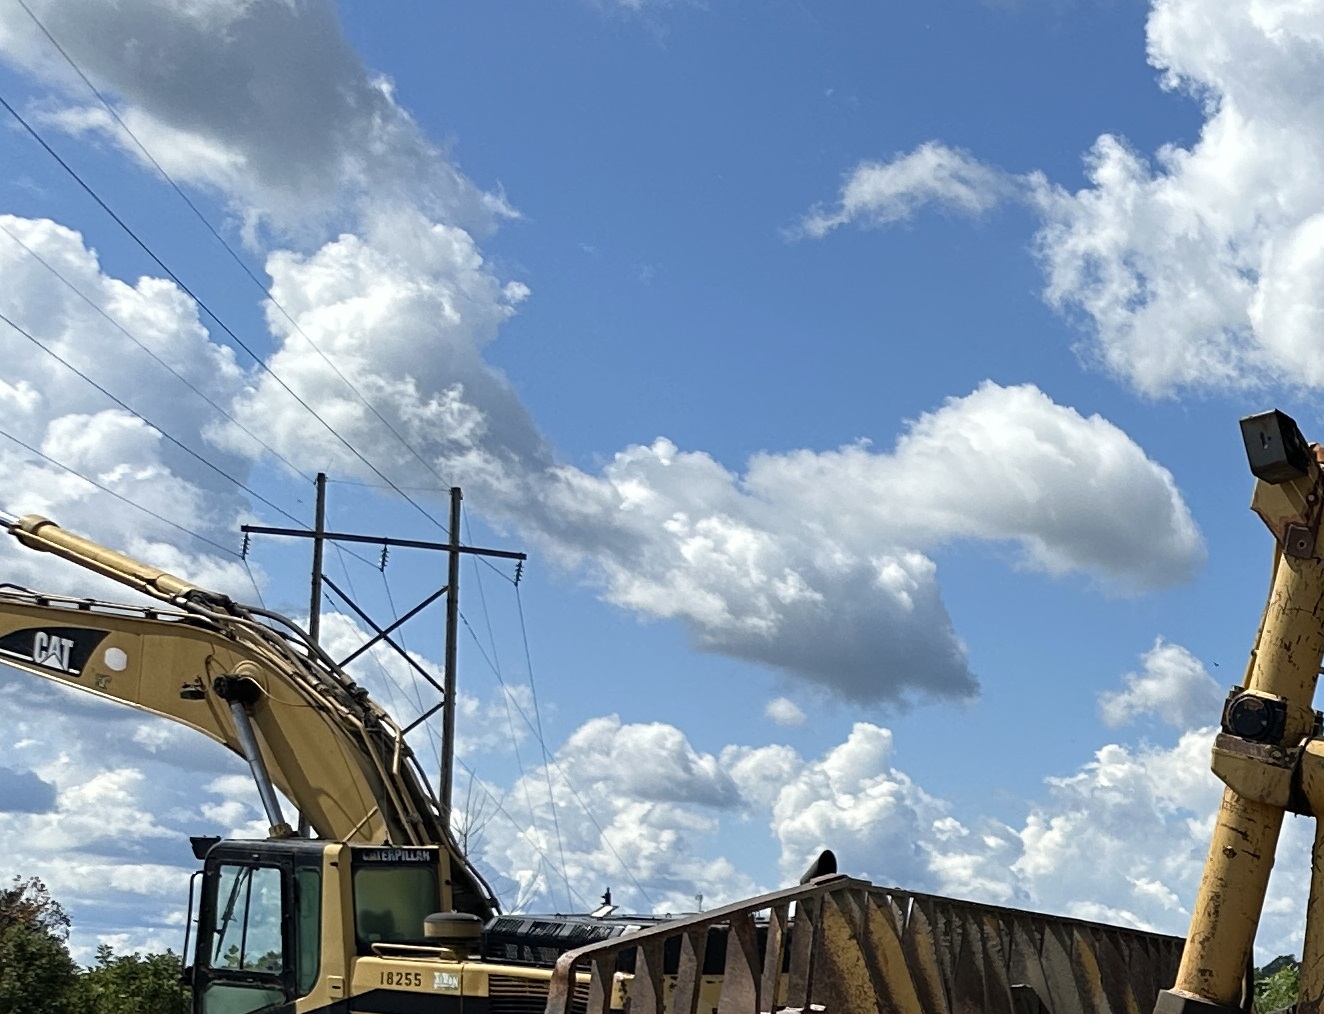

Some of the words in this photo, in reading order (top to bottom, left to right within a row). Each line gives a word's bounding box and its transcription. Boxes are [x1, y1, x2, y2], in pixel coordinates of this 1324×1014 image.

[34, 631, 75, 671] CAT
[362, 850, 431, 861] CATERPILLAR
[380, 971, 422, 987] 18255
